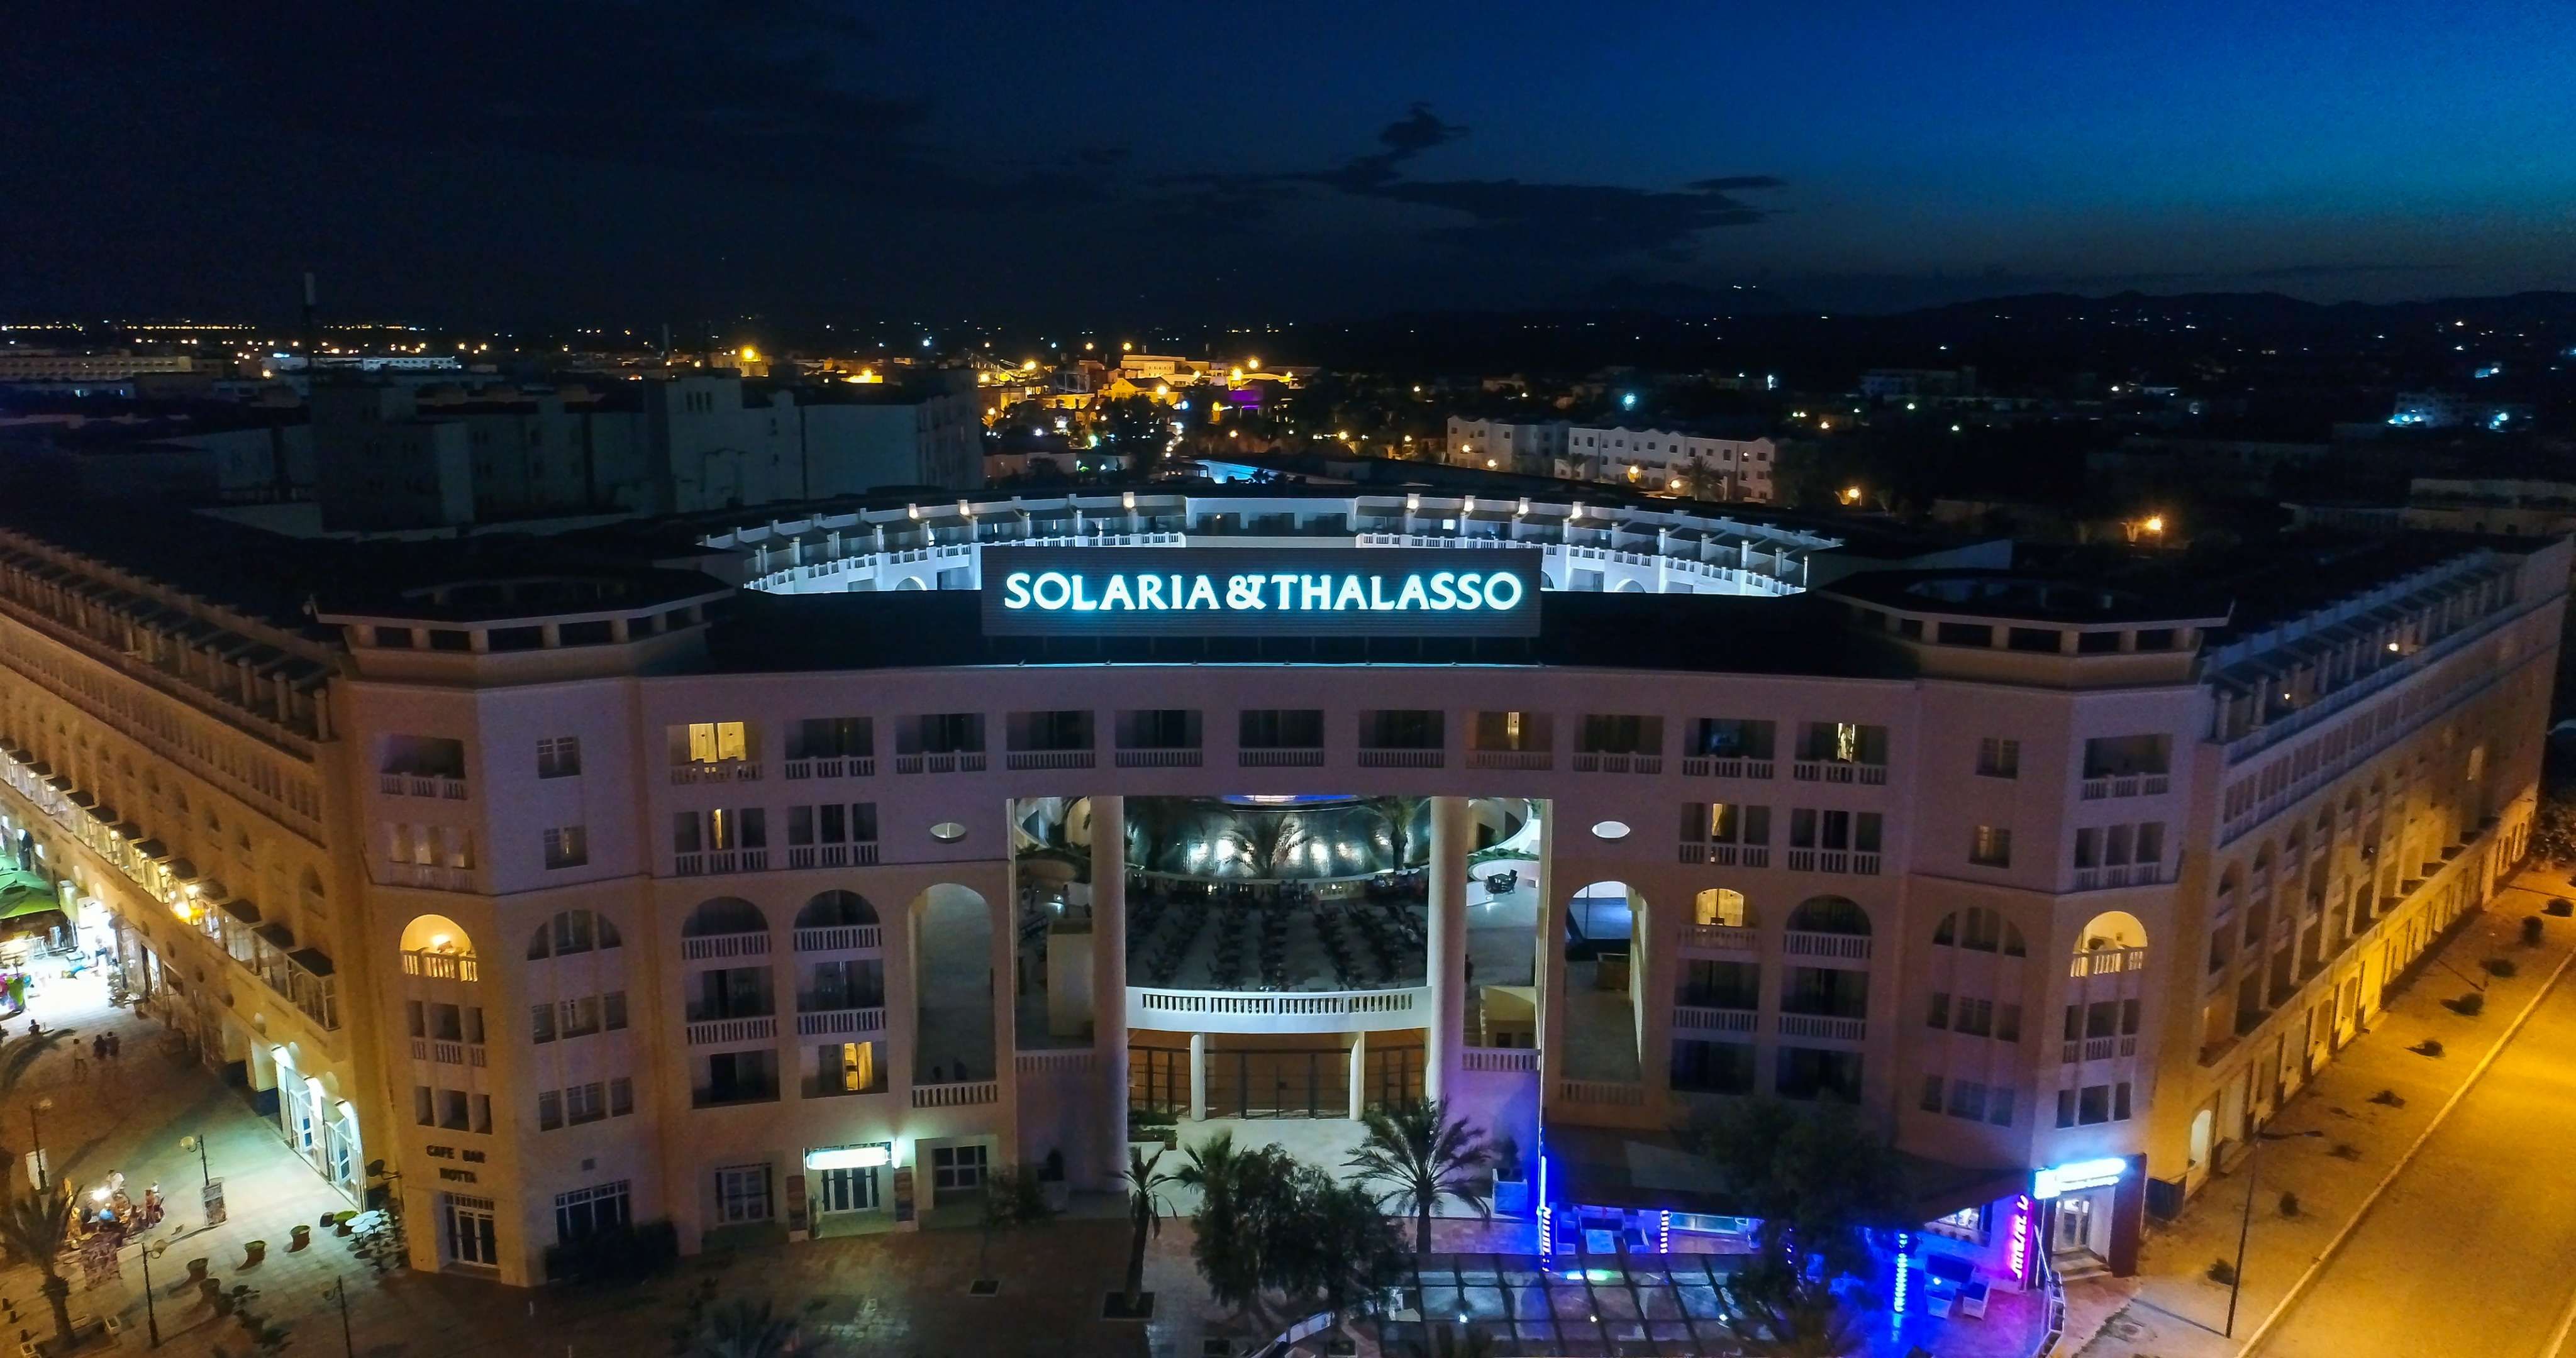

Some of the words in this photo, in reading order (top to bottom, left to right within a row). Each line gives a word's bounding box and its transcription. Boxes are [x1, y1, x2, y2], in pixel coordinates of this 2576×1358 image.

[1004, 572, 1221, 610] SOLARIA
[1270, 571, 1522, 610] THALASSO
[426, 1145, 454, 1159] CAFE
